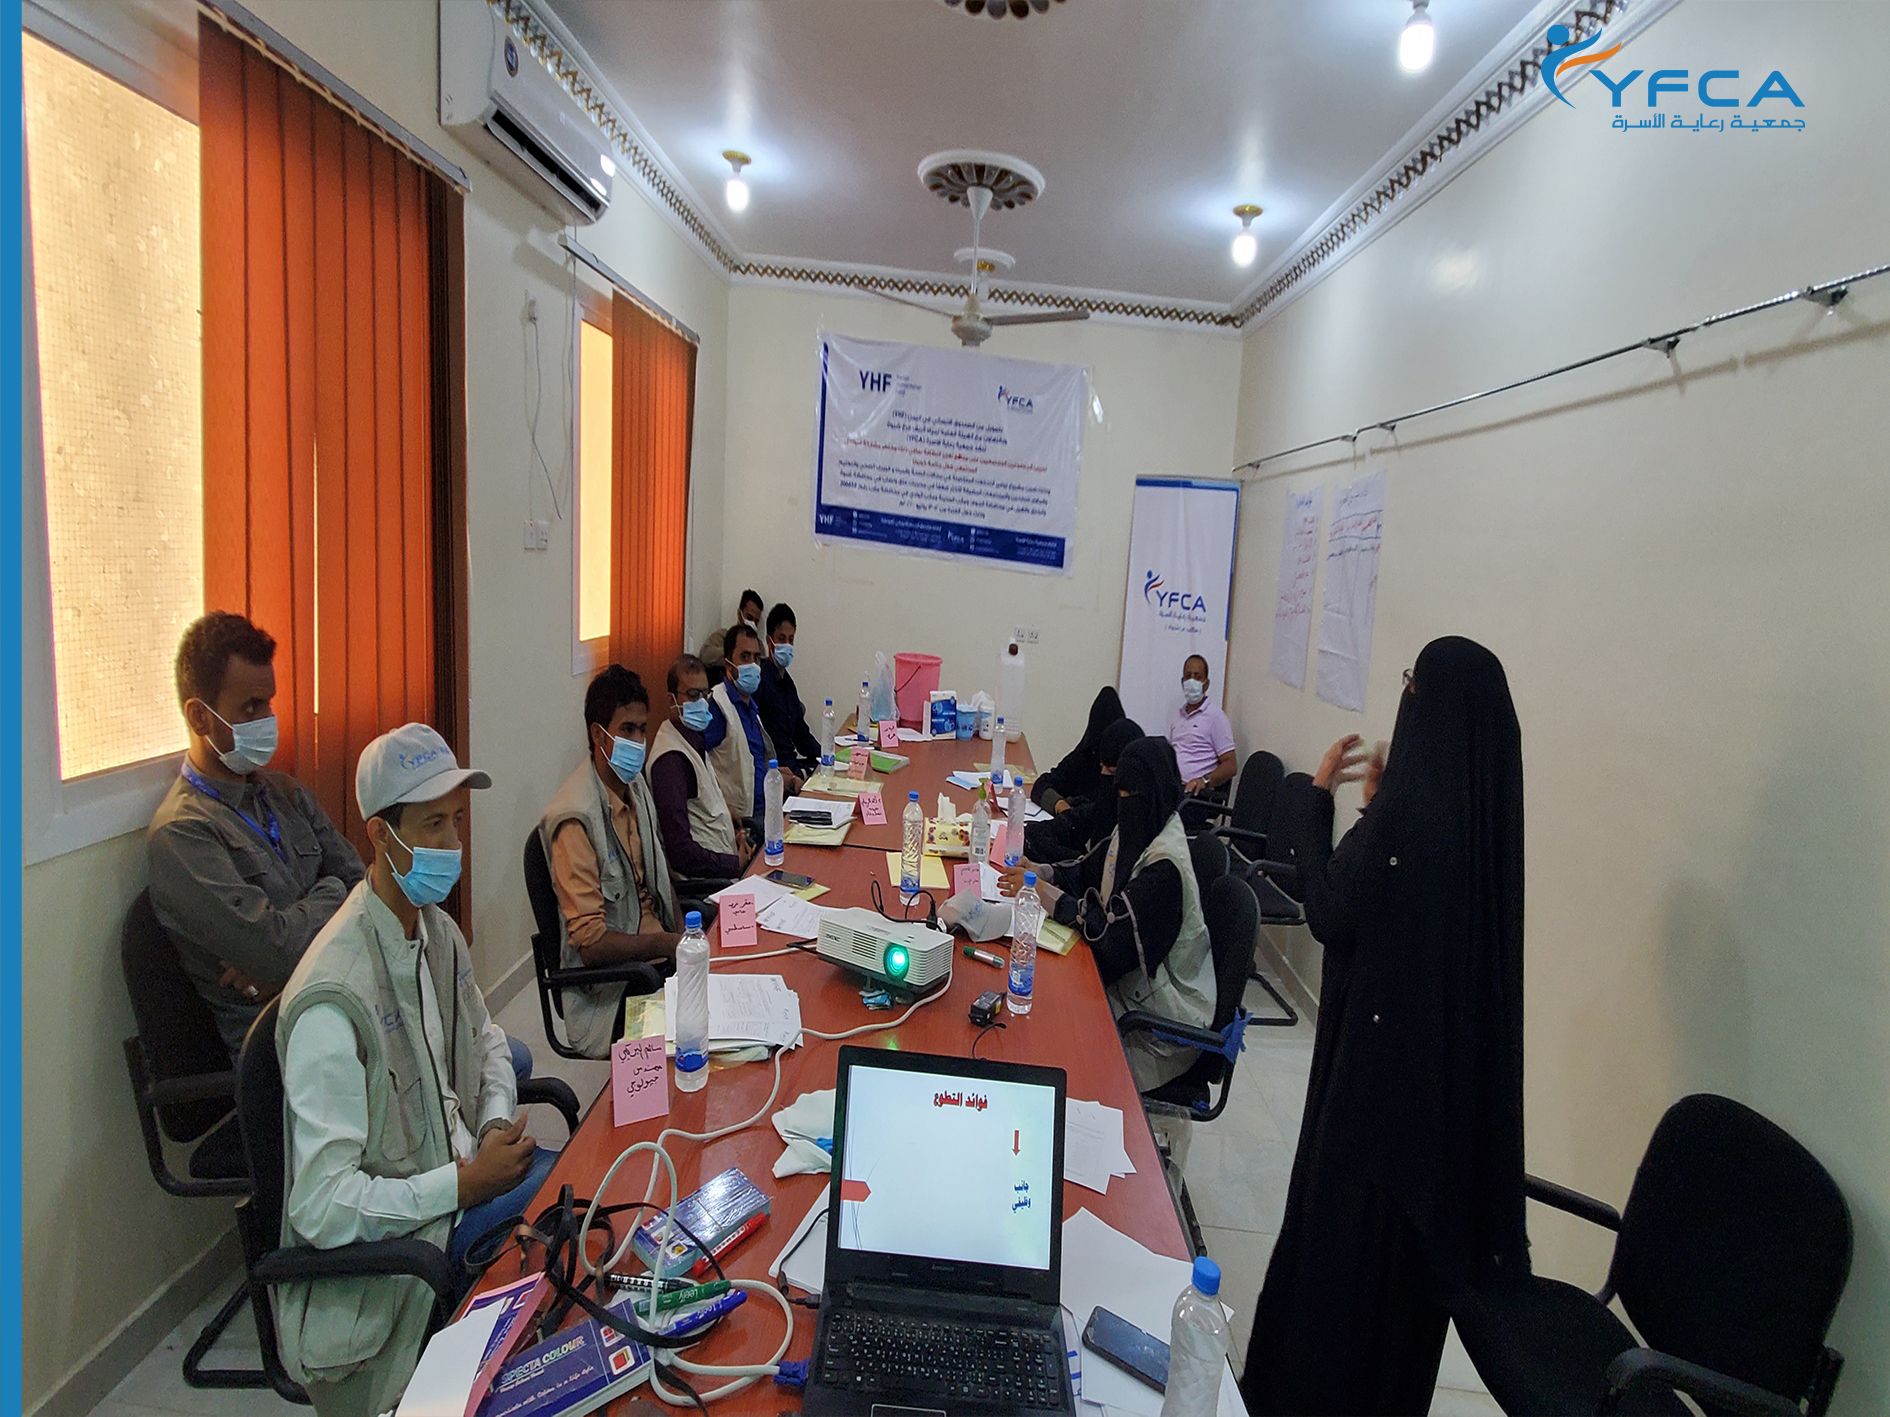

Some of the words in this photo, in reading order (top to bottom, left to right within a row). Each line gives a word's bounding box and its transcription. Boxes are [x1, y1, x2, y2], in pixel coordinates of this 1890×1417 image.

[859, 370, 892, 393] YHF
[1006, 395, 1034, 408] YFCA
[1156, 590, 1206, 612] YFCA
[933, 1090, 963, 1107] التطوع
[965, 1092, 988, 1111] فوائد
[1014, 1179, 1029, 1193] جانب
[1012, 1196, 1031, 1213] وظيفي
[501, 1358, 542, 1384] SPECTA
[541, 1335, 585, 1364] COLOUR
